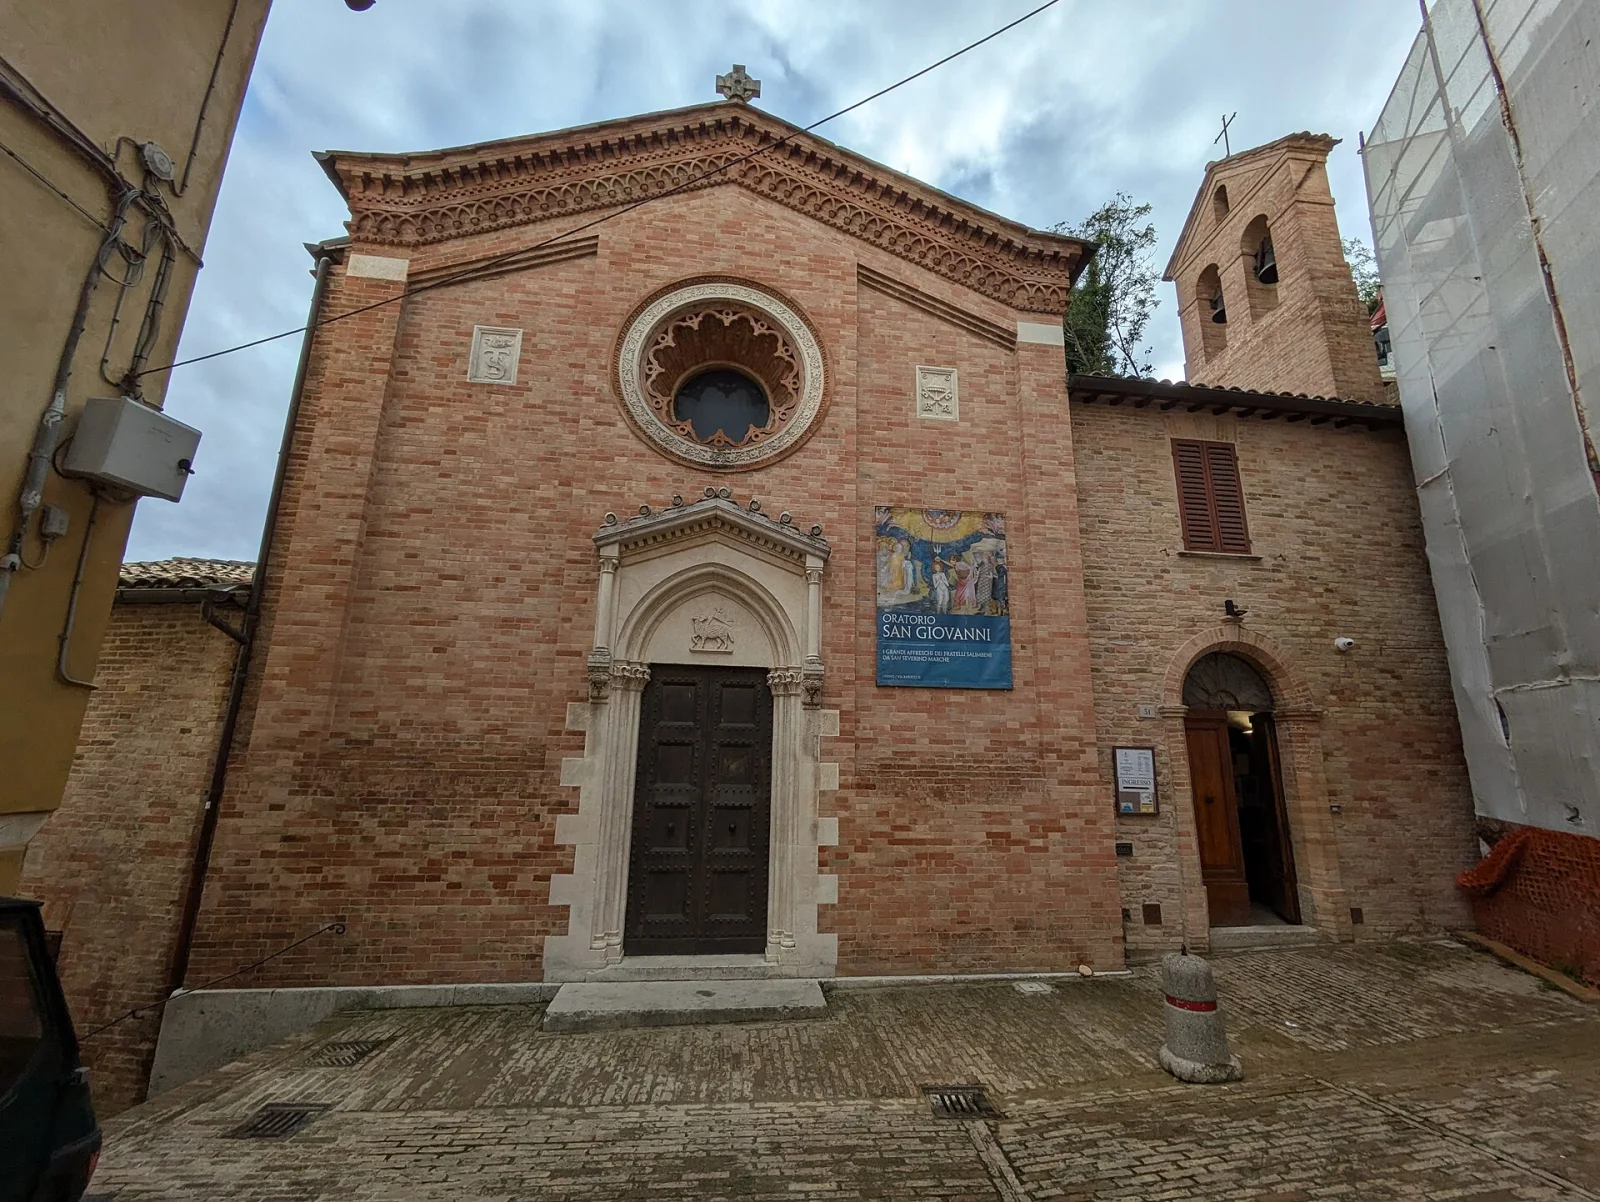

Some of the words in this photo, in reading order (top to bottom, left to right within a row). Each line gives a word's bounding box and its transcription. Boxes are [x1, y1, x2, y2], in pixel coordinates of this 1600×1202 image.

[882, 613, 936, 625] ORATORIO
[882, 624, 911, 639] SAN
[915, 626, 991, 641] GIOVANNI
[1121, 778, 1152, 786] INGRESSO
